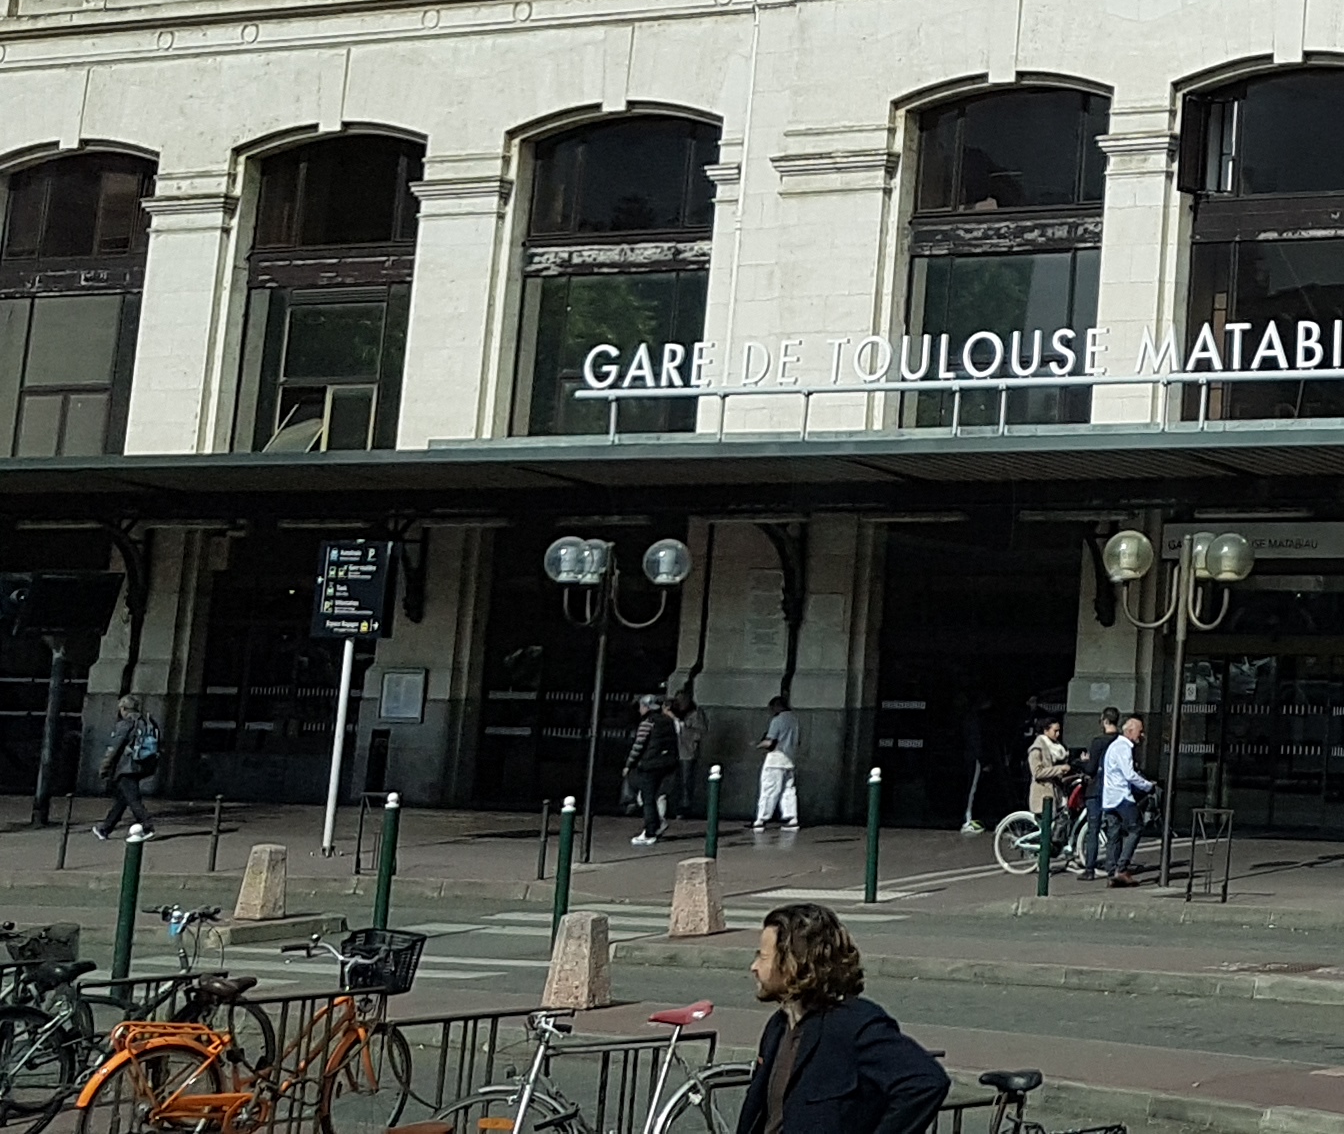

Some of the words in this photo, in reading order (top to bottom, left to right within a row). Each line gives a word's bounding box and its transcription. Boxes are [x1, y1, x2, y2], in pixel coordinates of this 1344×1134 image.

[583, 341, 716, 389] GARE
[742, 340, 803, 387] DE
[826, 328, 1110, 385] TOULOUSE
